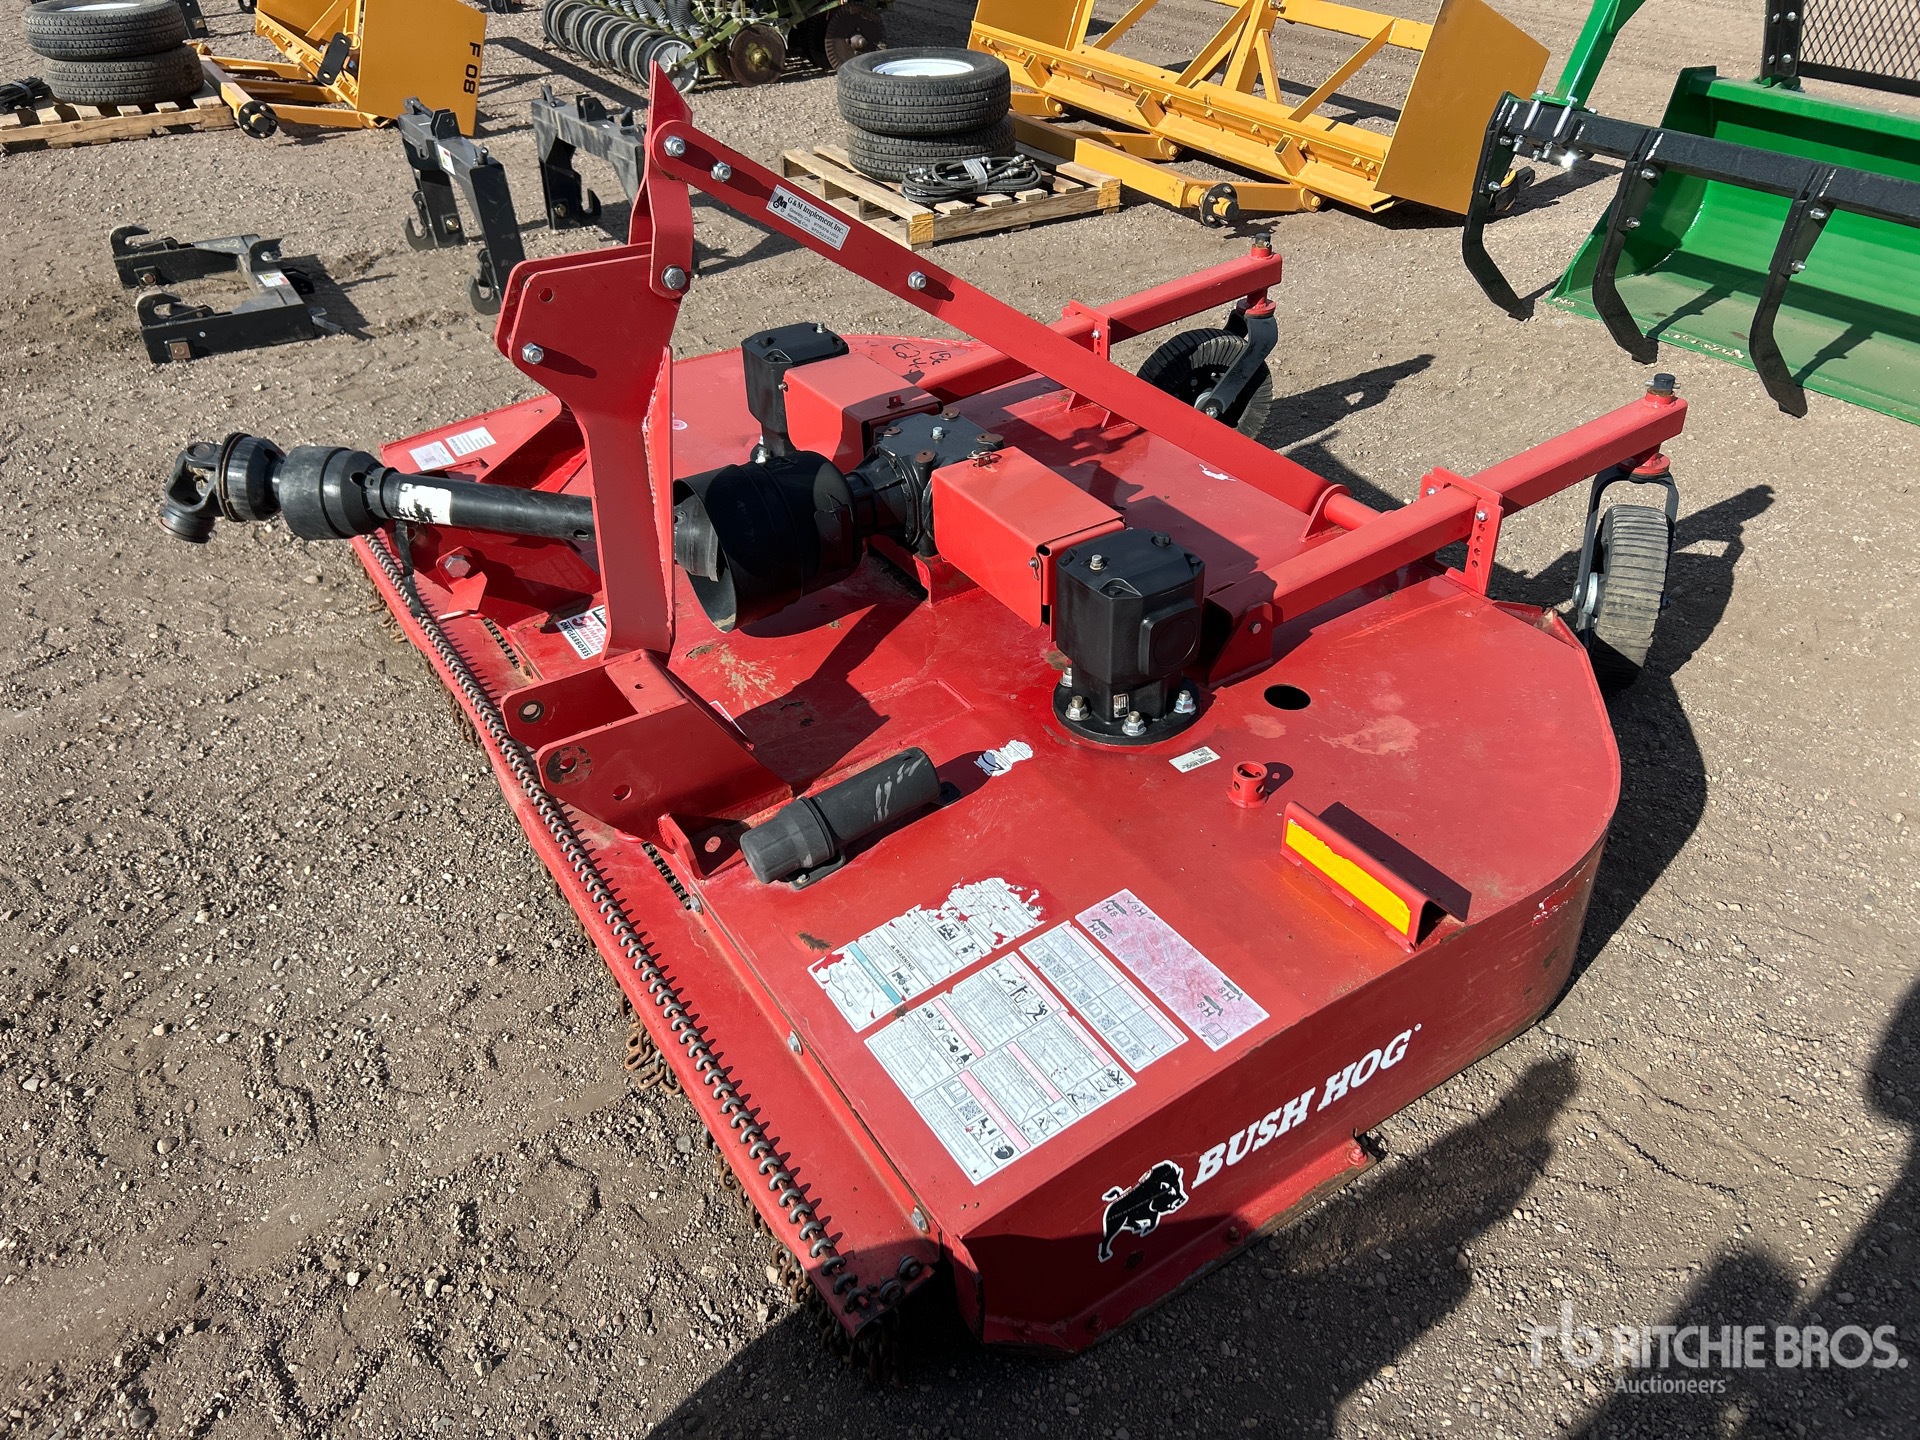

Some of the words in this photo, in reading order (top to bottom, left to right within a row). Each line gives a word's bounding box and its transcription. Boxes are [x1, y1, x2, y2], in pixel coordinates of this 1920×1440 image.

[469, 41, 481, 57] F
[463, 63, 478, 94] 08
[566, 629, 590, 657] GEARBOXES
[1095, 929, 1107, 940] 80
[895, 948, 915, 970] WARNING
[1191, 1087, 1316, 1189] BUSH
[1317, 1029, 1412, 1112] HOG
